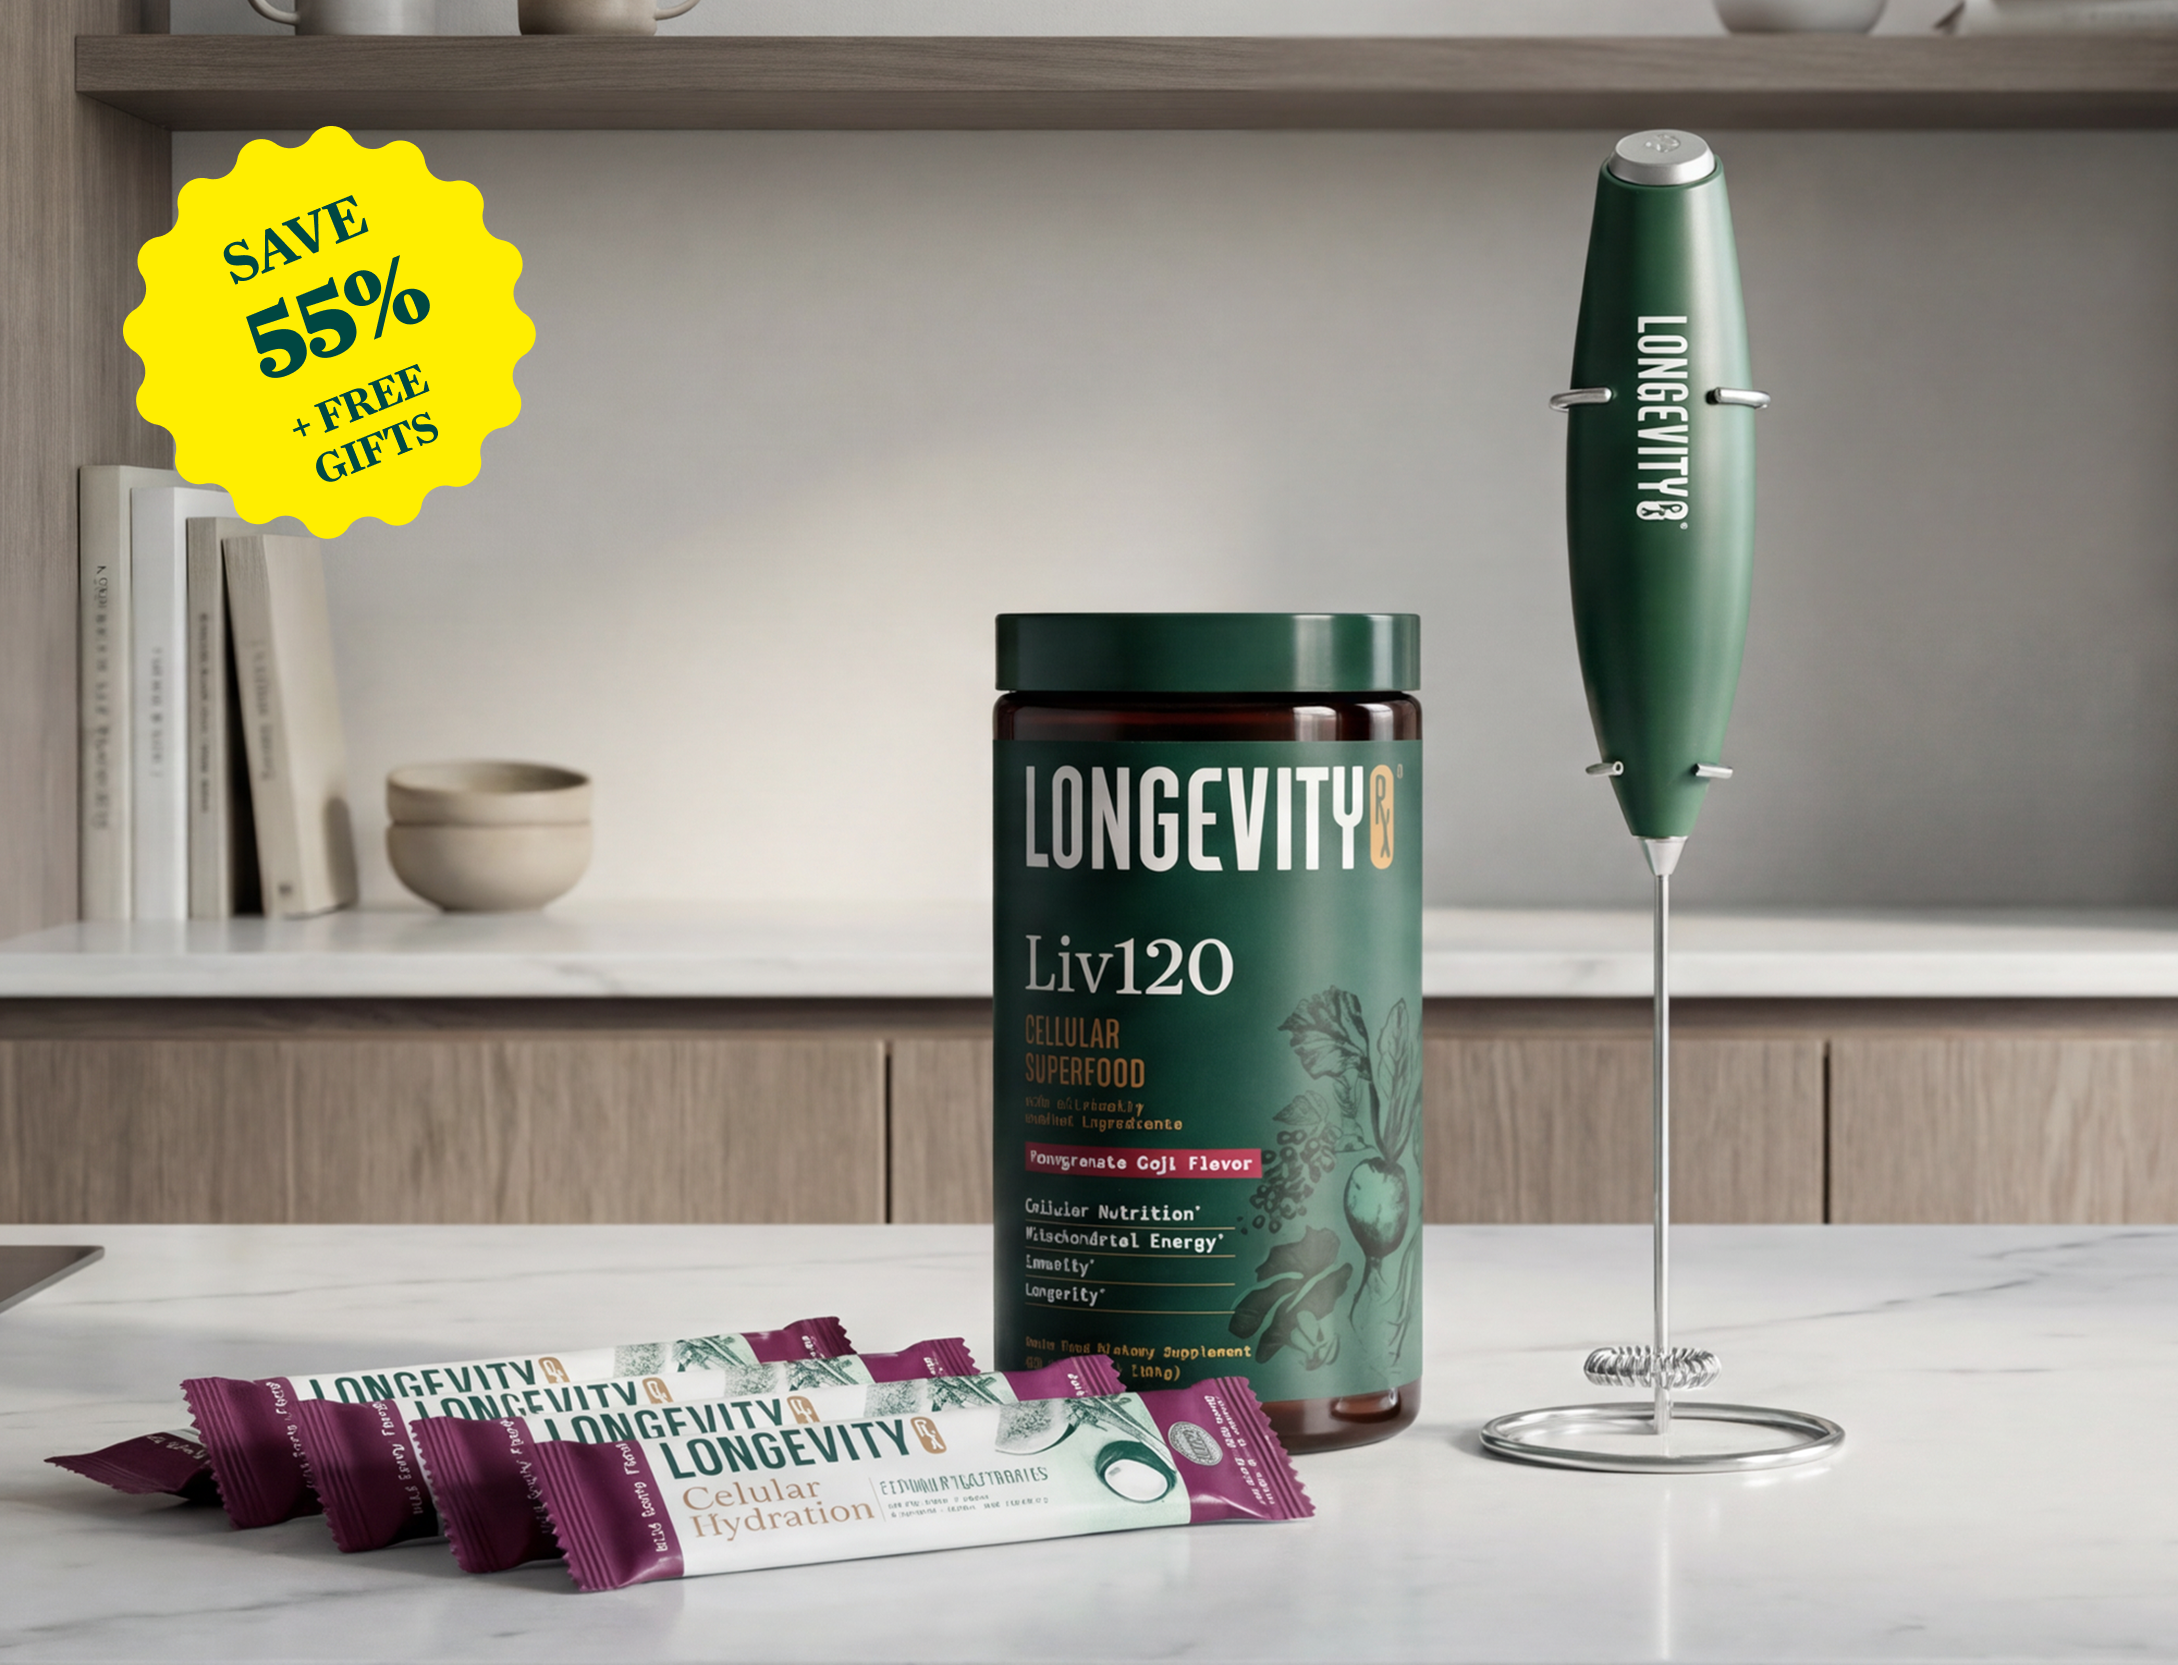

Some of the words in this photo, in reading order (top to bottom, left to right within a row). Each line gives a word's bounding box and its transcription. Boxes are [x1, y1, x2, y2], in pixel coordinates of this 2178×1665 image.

[1637, 316, 1688, 497] LONGEVITY
[1026, 765, 1364, 872] LONGEVITY
[1025, 934, 1234, 996] Liv120
[1025, 1014, 1120, 1049] CELLULAR
[1025, 1052, 1145, 1088] SUPERFOOD
[659, 1419, 910, 1479] LONGEVITY
[682, 1478, 821, 1511] Celular
[689, 1501, 875, 1541] Hydration
